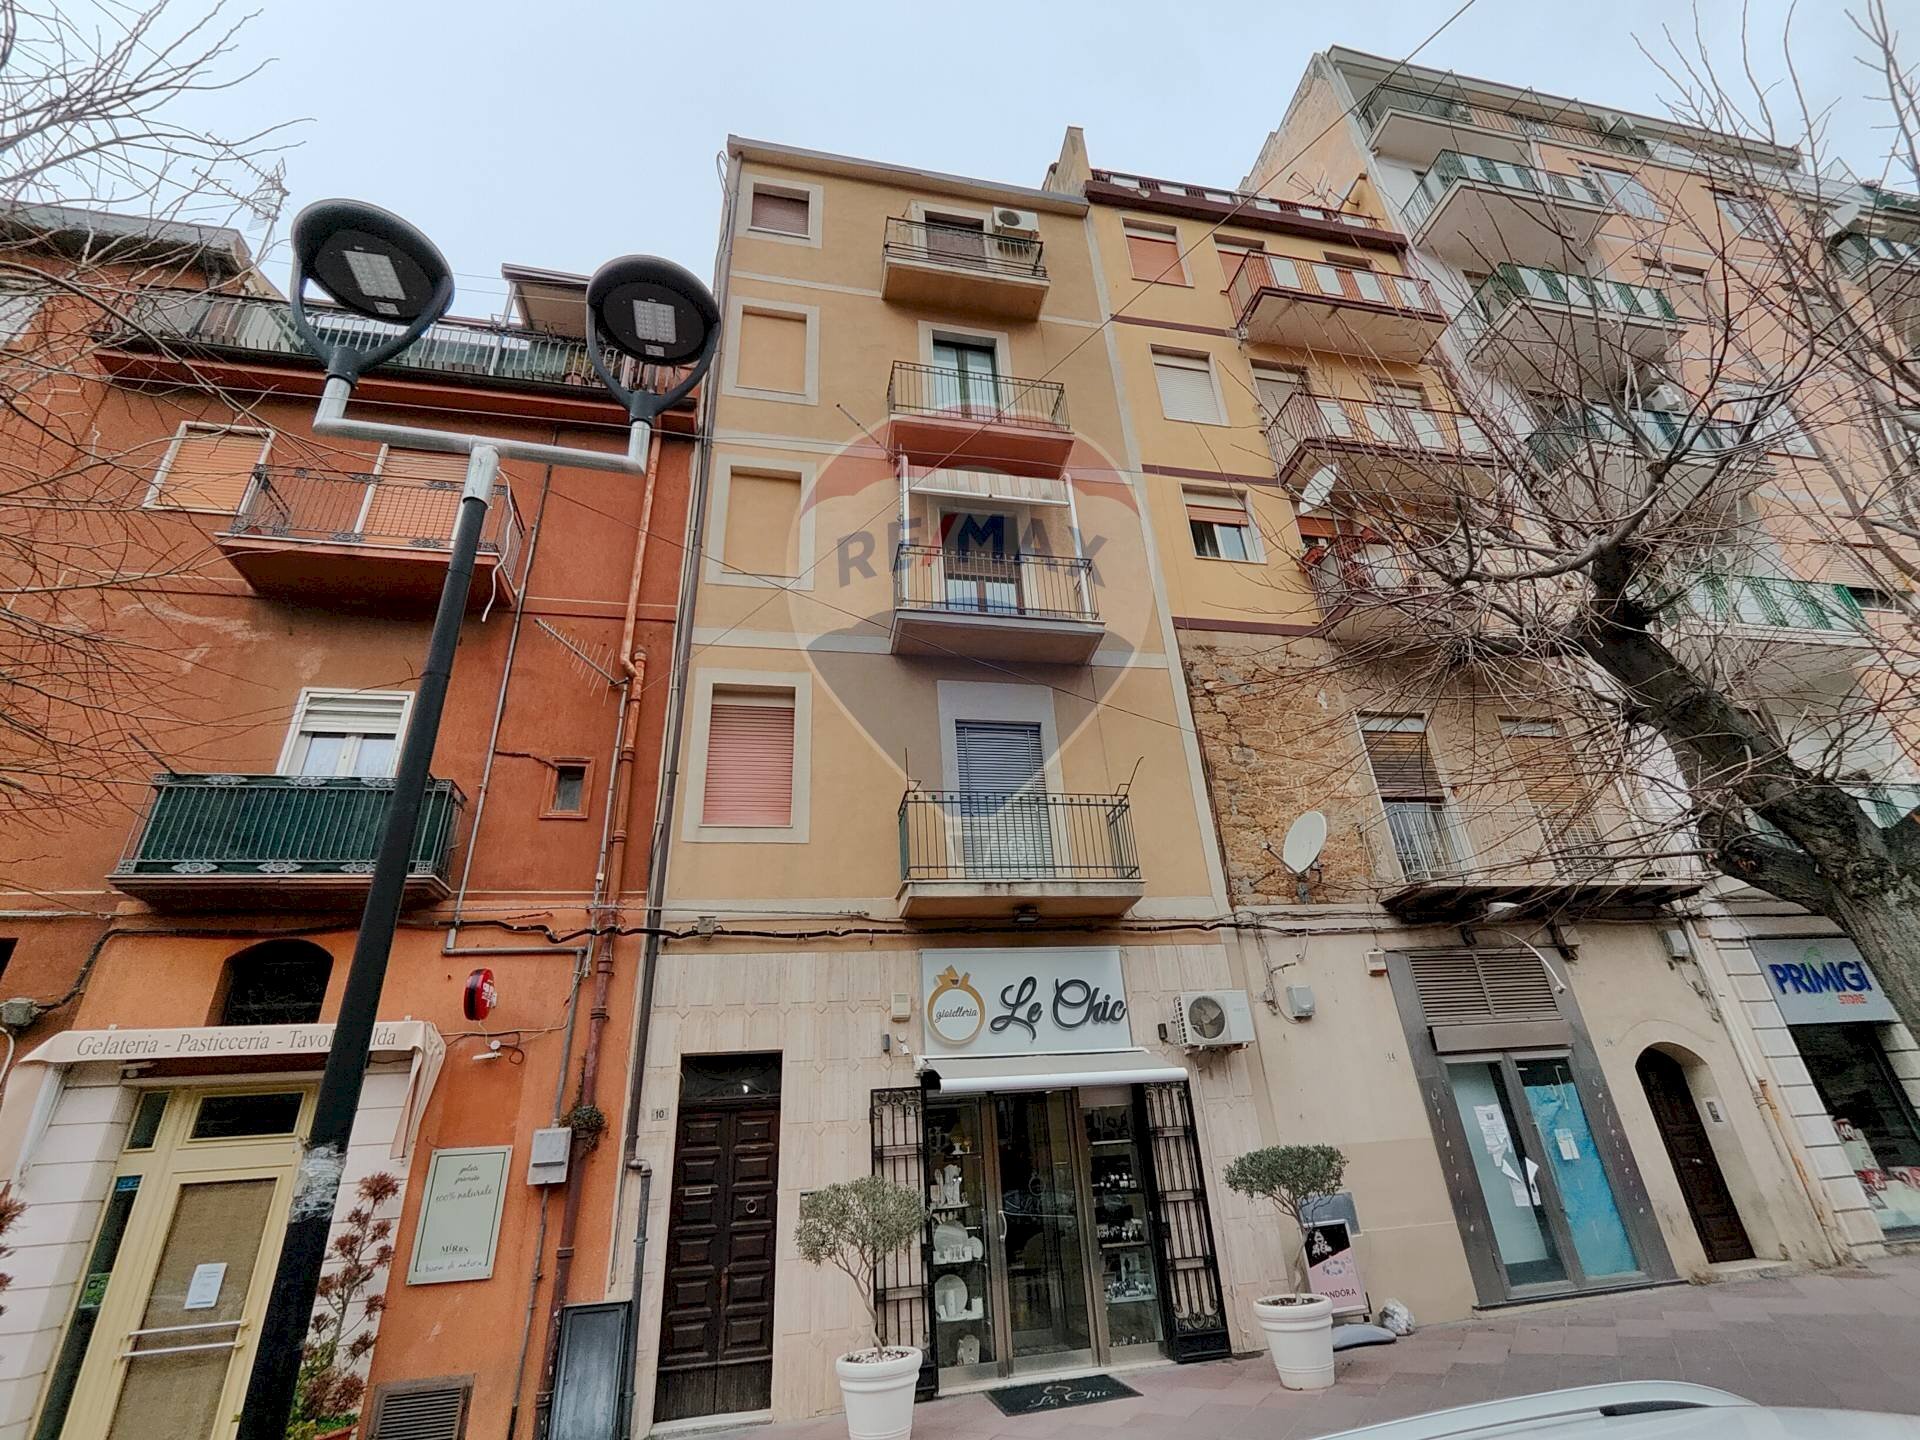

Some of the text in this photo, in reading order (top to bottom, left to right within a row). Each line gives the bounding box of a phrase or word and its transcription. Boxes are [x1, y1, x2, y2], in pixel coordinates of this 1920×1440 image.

[1768, 961, 1873, 994] PRIMIGI
[935, 1005, 978, 1024] gioielleria
[990, 976, 1127, 1041] Le Chic
[76, 1034, 159, 1056] Gelateria
[176, 1031, 270, 1053] Pasticceria
[289, 1028, 337, 1049] Tavol
[371, 1028, 396, 1046] lda
[655, 1109, 665, 1120] 10
